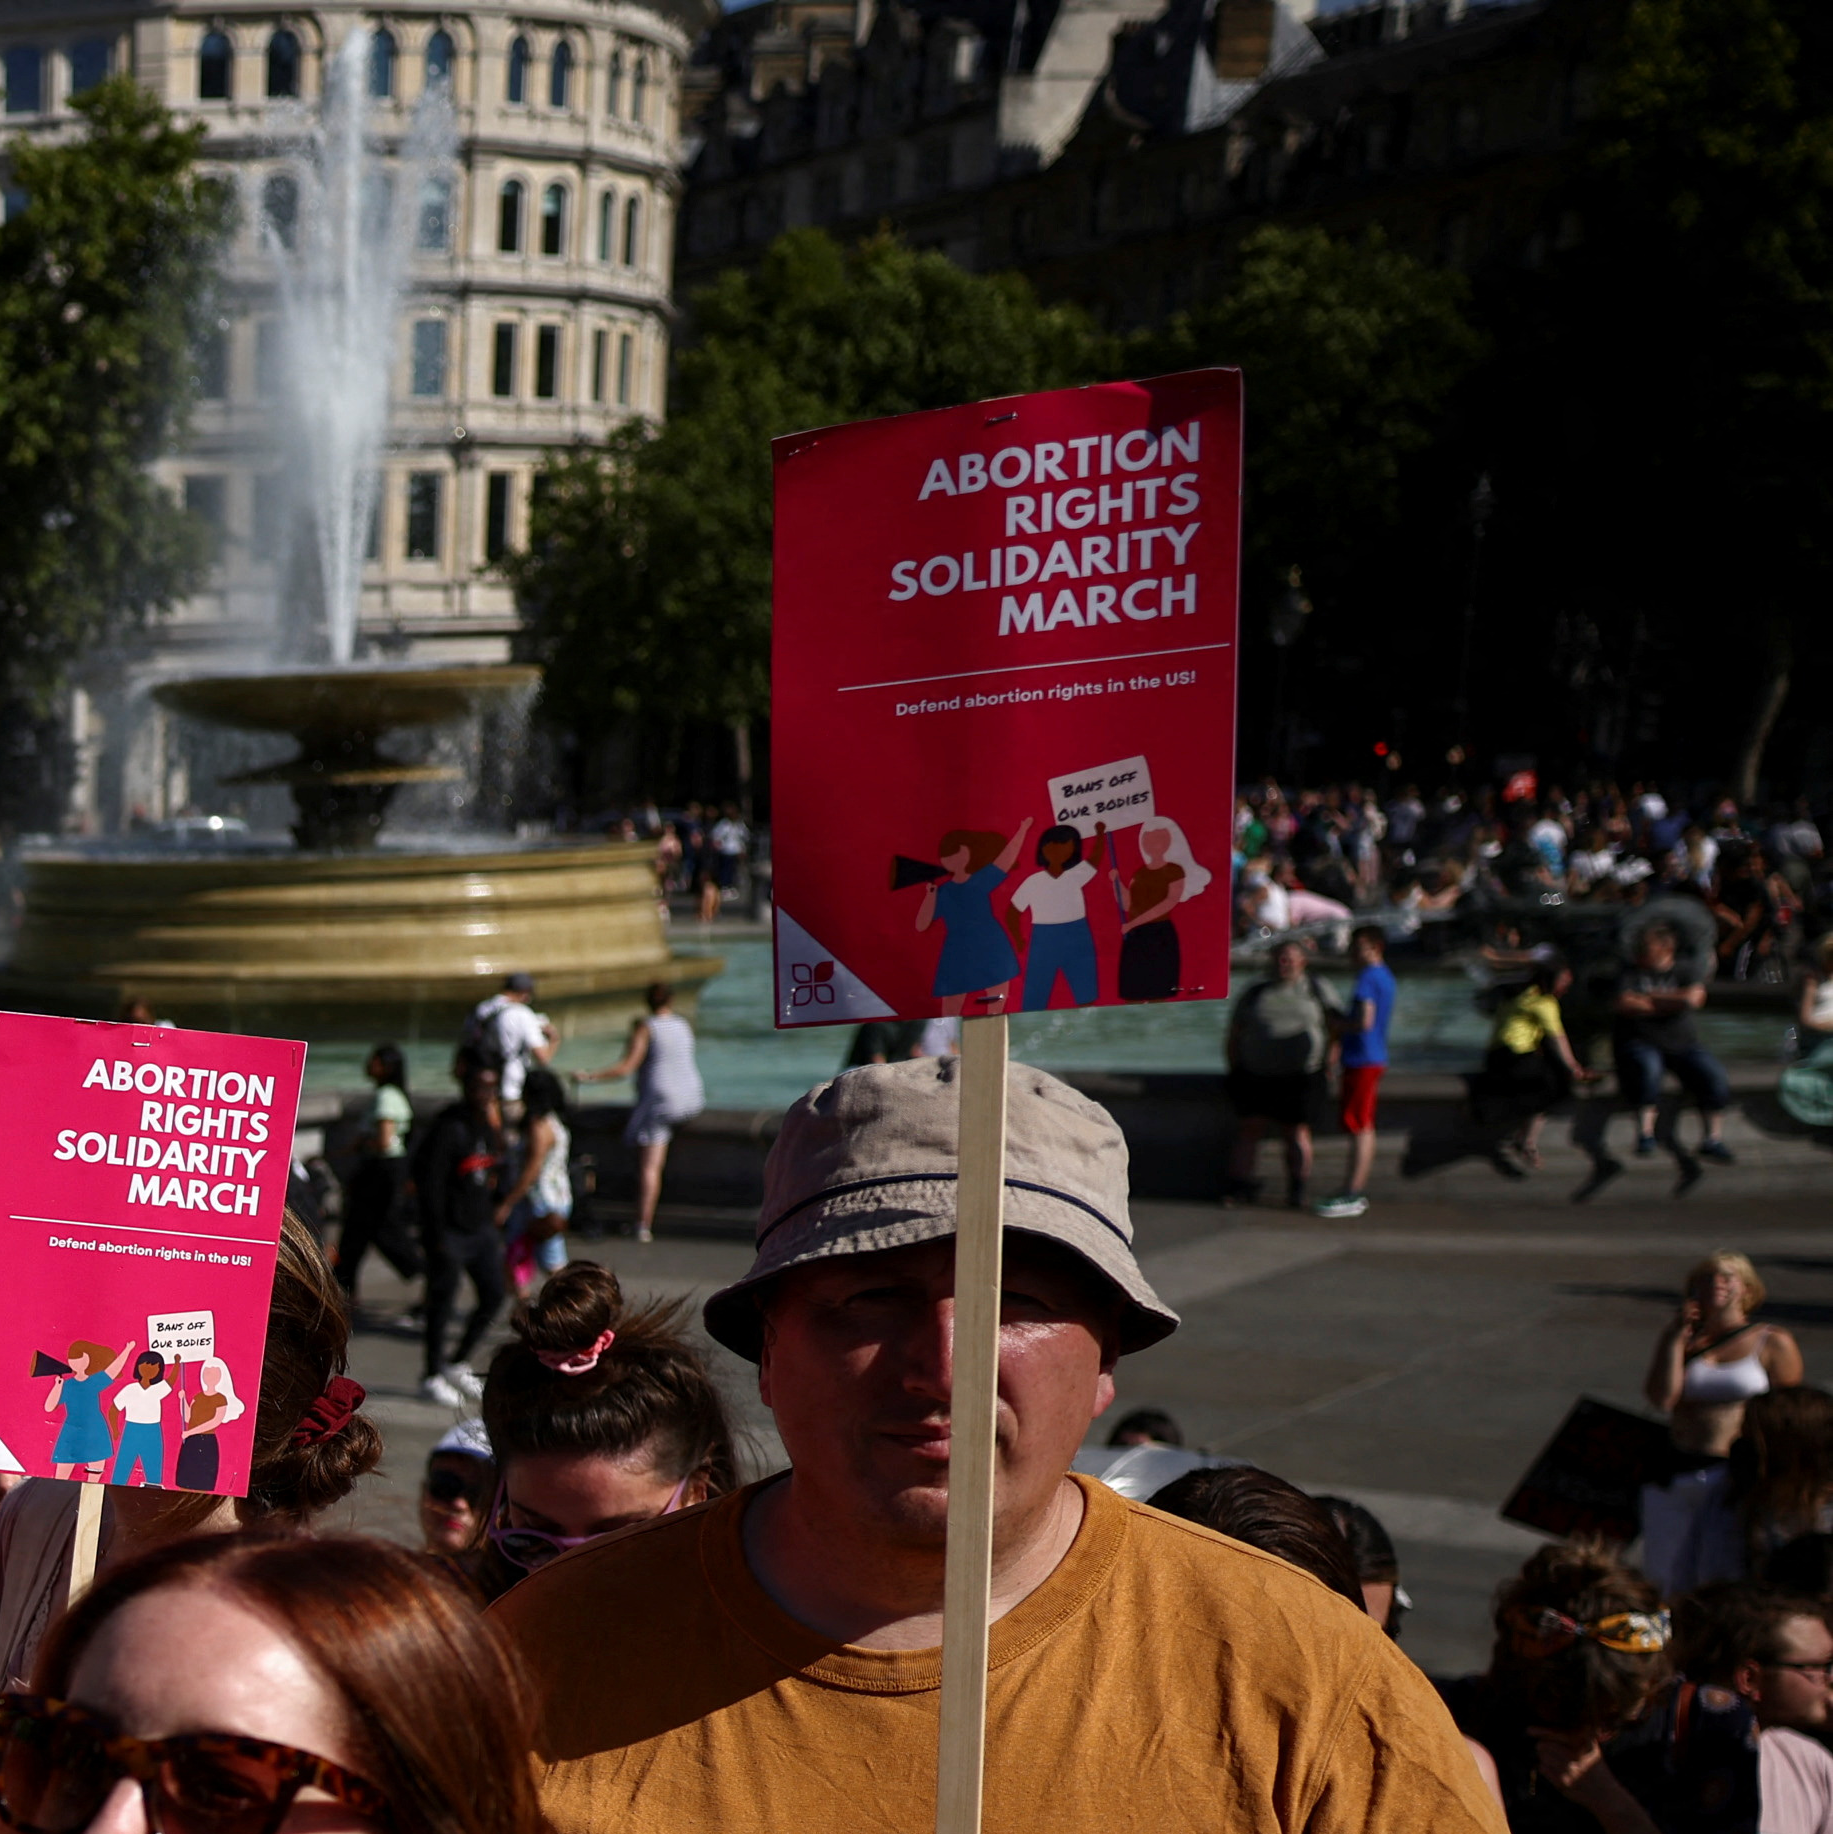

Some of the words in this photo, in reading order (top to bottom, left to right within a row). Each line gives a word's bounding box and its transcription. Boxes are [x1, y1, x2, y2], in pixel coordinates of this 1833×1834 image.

[918, 421, 1201, 501] ABORTION
[1005, 473, 1201, 537] RIGHTS
[888, 521, 1202, 603] SOLIDARITY
[997, 573, 1197, 637] MARCH
[895, 696, 960, 716] Defend
[964, 688, 1043, 708] abortion
[1047, 682, 1103, 702] rights
[1107, 678, 1125, 693] in
[1128, 675, 1161, 690] the
[1165, 670, 1197, 685] US!
[82, 1058, 275, 1107] ABORTION
[140, 1101, 270, 1143] RIGHTS
[53, 1130, 268, 1180] SOLIDARITY
[127, 1174, 260, 1216] MARCH
[49, 1236, 96, 1250] Defend
[98, 1242, 153, 1257] abortion
[155, 1247, 192, 1261] rights
[194, 1251, 205, 1262] in
[208, 1253, 229, 1264] the
[231, 1255, 252, 1266] US!
